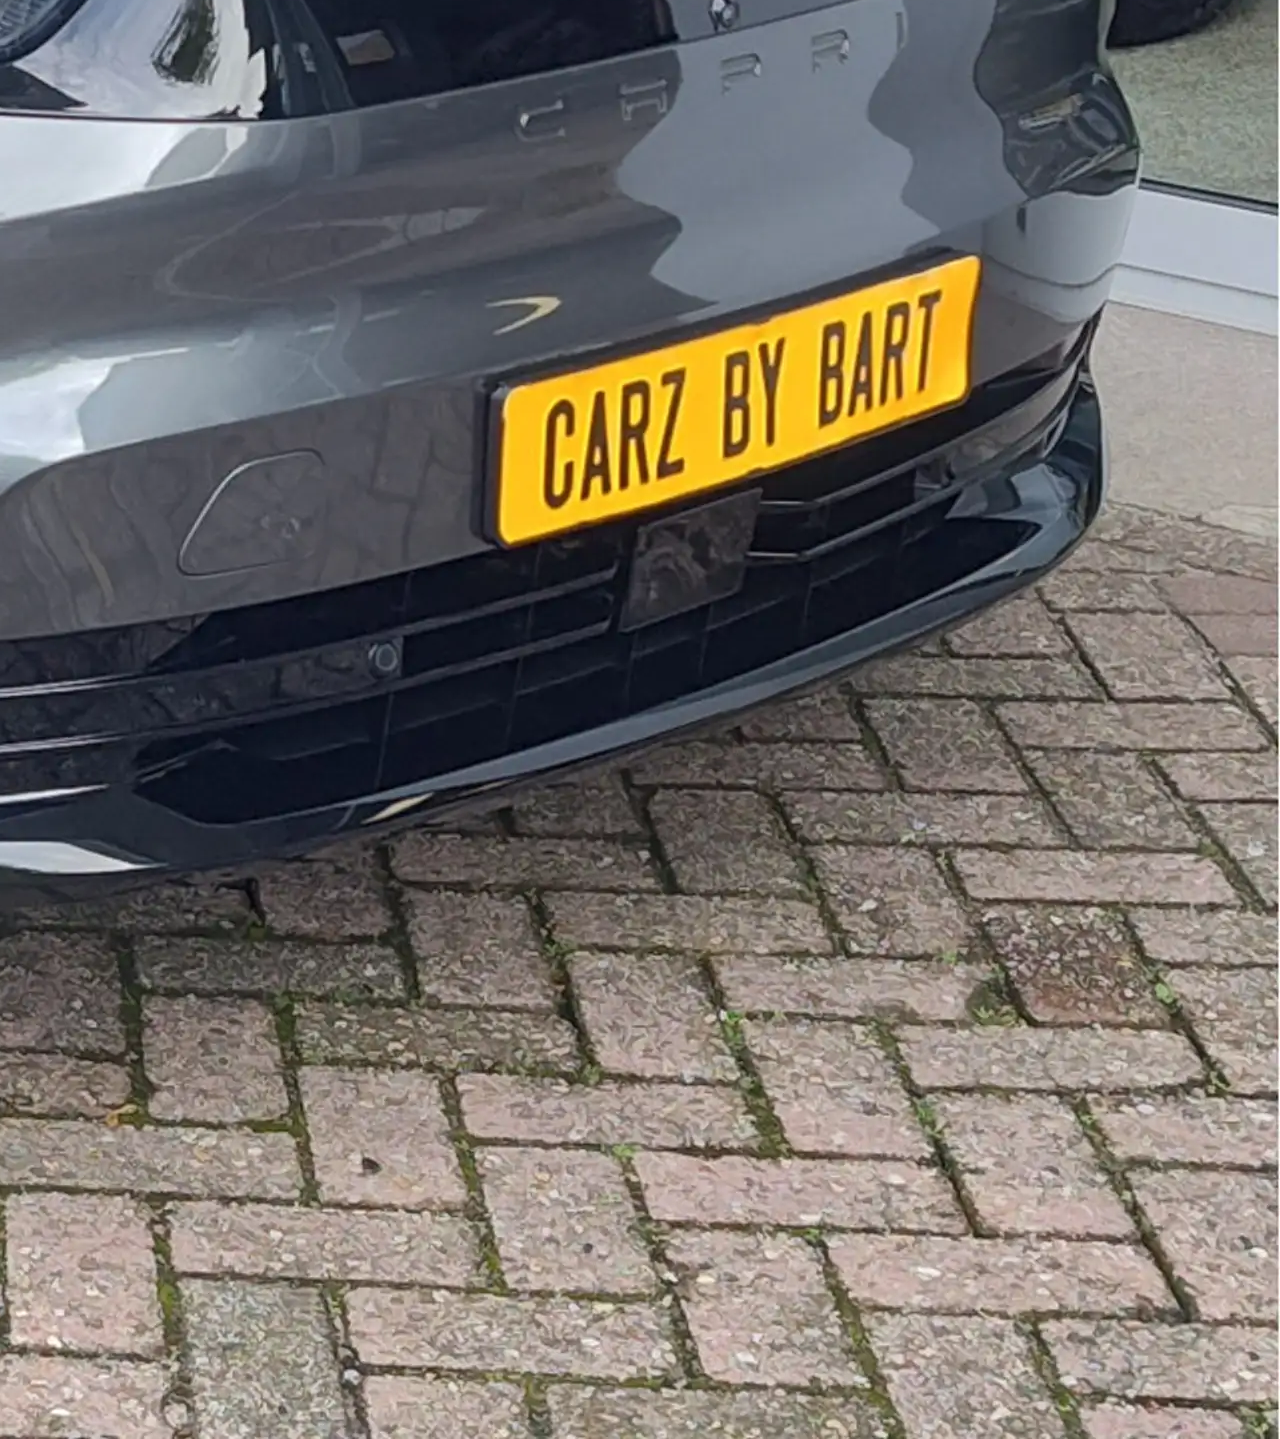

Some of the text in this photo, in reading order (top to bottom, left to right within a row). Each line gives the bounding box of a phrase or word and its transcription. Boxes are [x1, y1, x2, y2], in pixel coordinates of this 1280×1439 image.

[513, 11, 909, 142] CAPRI
[543, 289, 942, 510] CARZ BY BART
